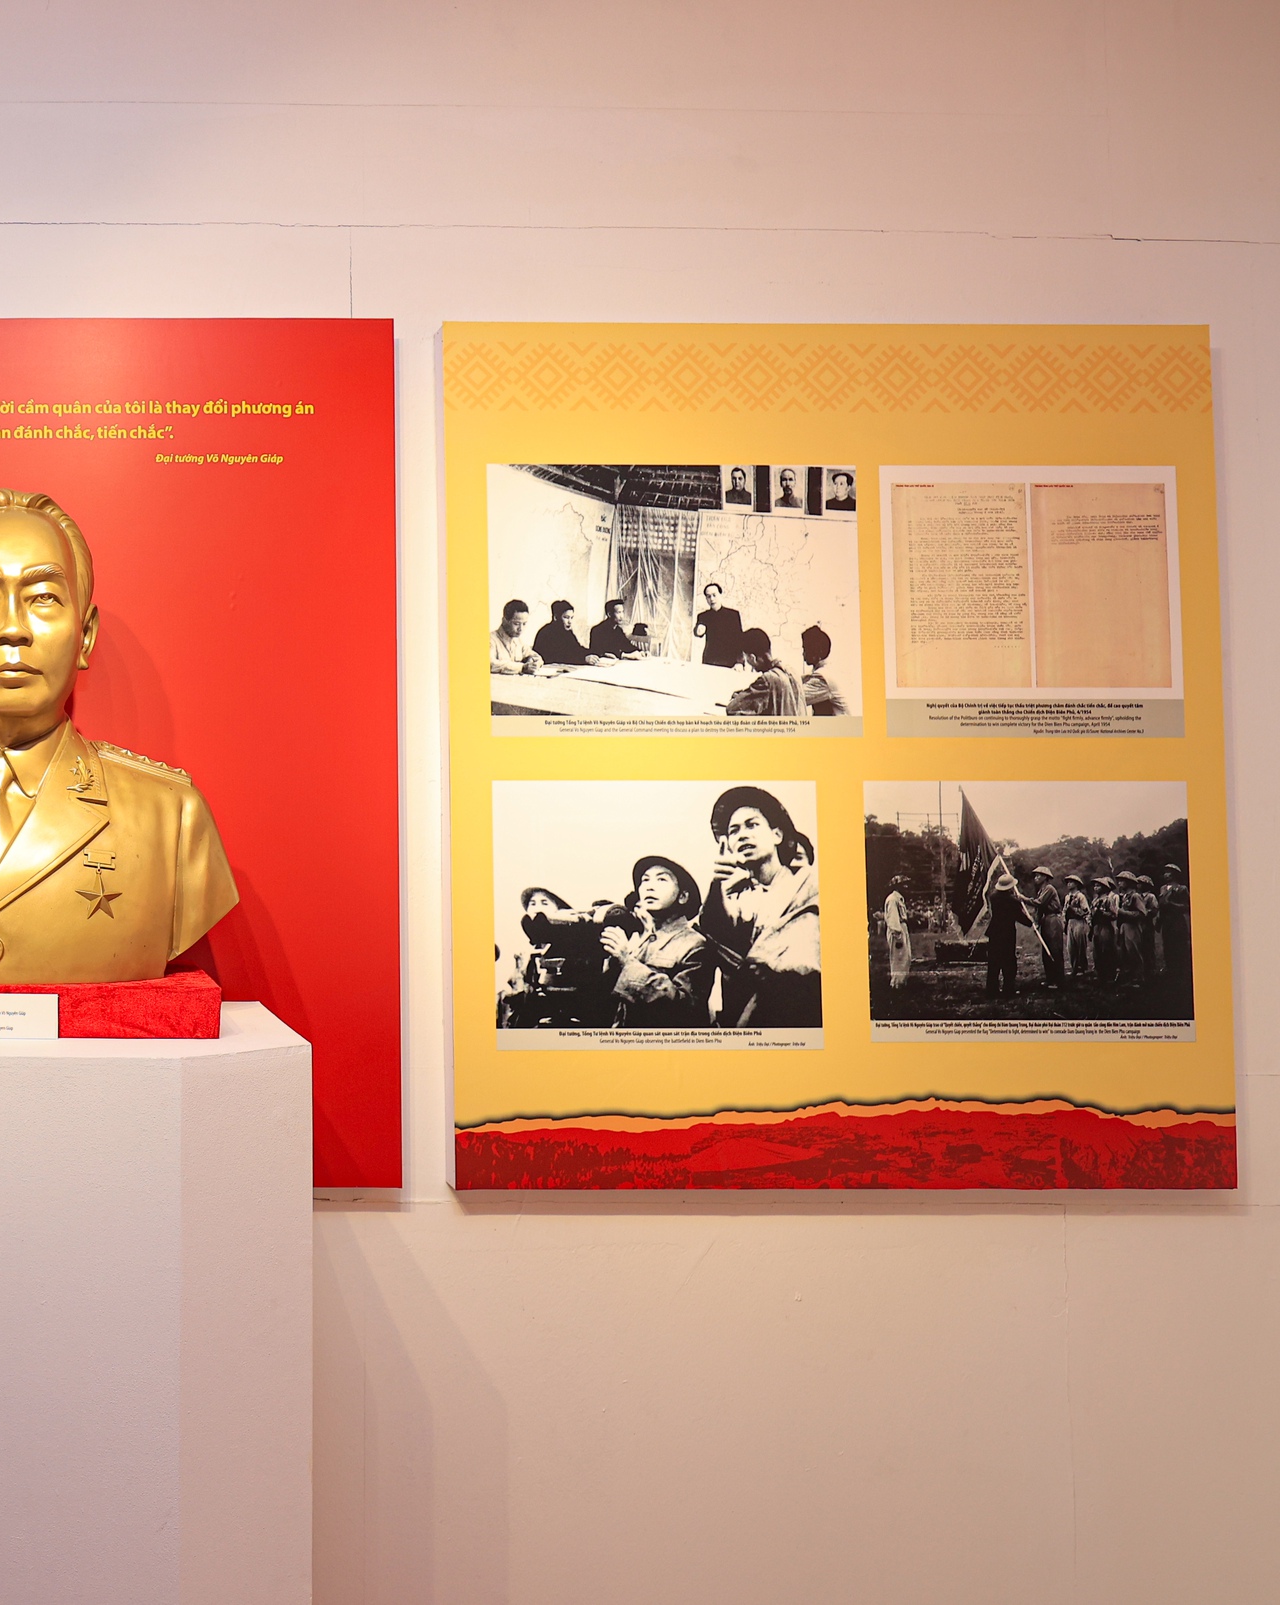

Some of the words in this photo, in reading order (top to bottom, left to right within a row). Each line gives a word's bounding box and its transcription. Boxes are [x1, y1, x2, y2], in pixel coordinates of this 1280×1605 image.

[17, 399, 49, 414] cầm
[52, 401, 91, 417] quân
[95, 400, 121, 414] của
[125, 401, 145, 414] tôi
[149, 400, 162, 414] là
[165, 400, 200, 417] thay
[203, 398, 228, 414] đổi
[231, 400, 292, 418] phương
[295, 401, 314, 414] án
[13, 425, 53, 439] đánh
[55, 424, 94, 440] chắc,
[97, 424, 127, 439] tiến
[155, 454, 173, 465] Đại
[175, 453, 204, 465] tướng
[206, 454, 219, 463] Võ
[220, 454, 258, 465] Nguyên
[260, 454, 284, 465] Giáp
